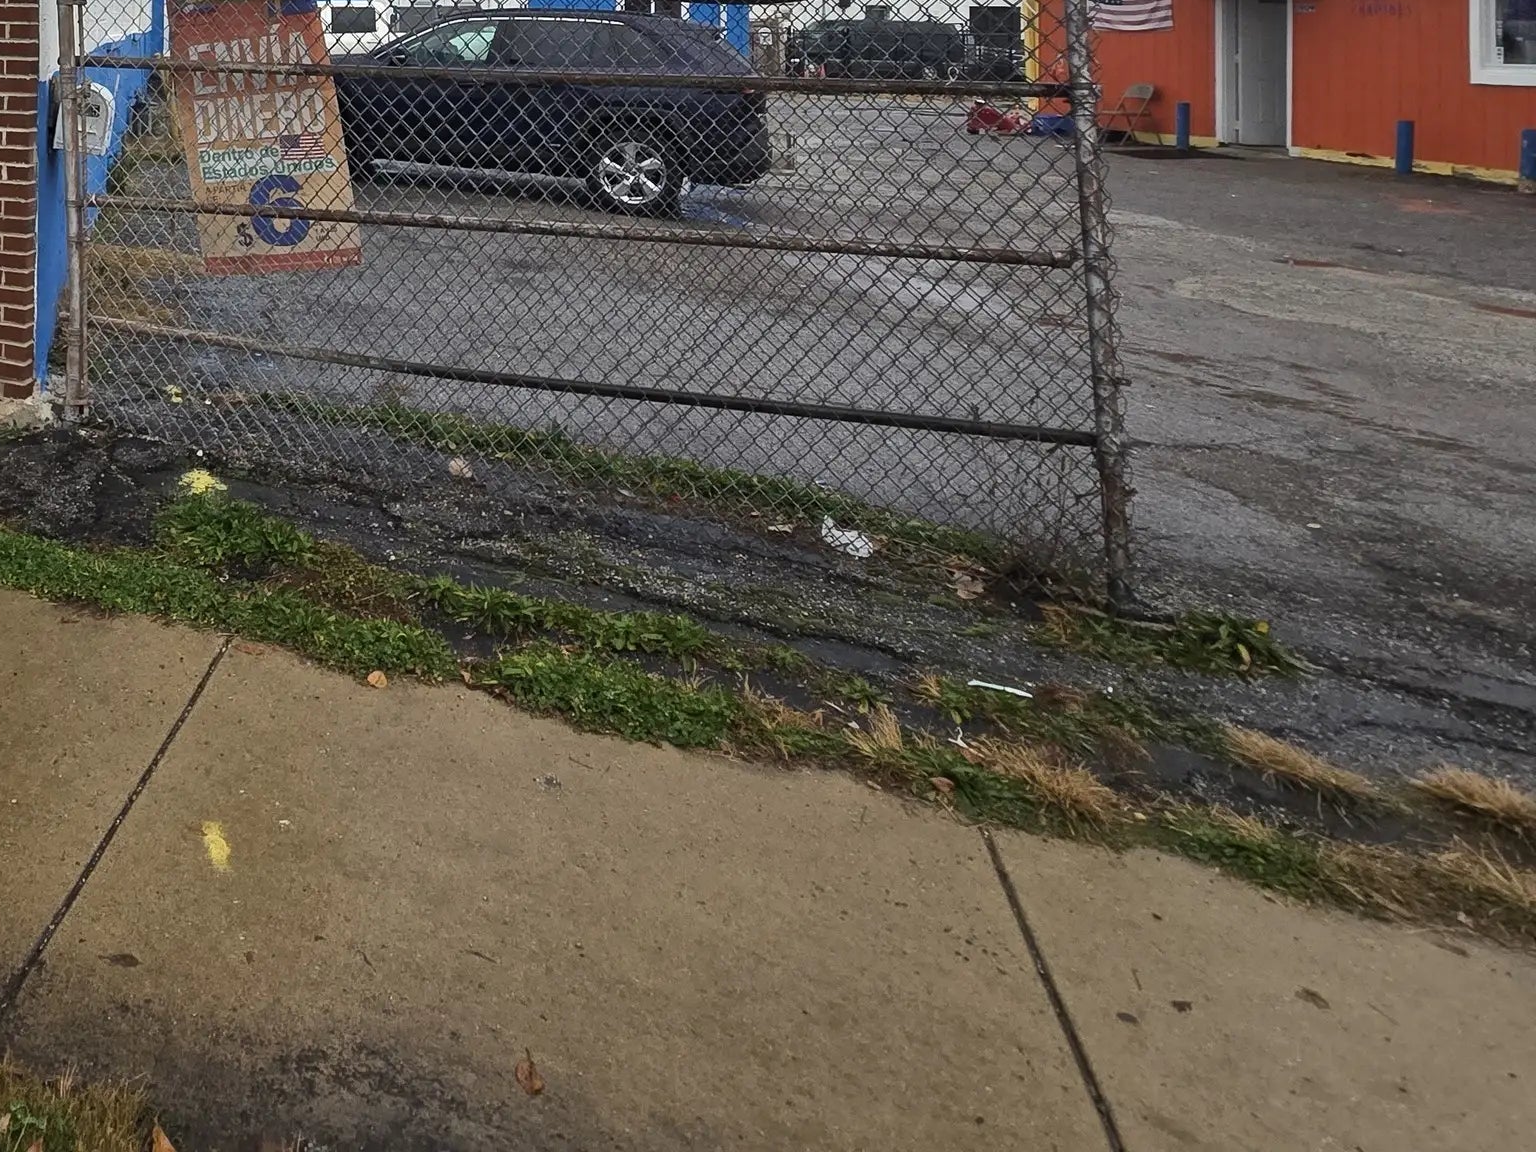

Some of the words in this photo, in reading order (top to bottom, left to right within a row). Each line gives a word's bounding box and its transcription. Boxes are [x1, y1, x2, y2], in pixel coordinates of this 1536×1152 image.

[188, 23, 319, 95] ENVÍA
[193, 88, 327, 144] DINERO
[199, 148, 254, 164] Dentro
[260, 145, 280, 158] de
[202, 163, 269, 180] Estados
[275, 158, 334, 175] Unidos
